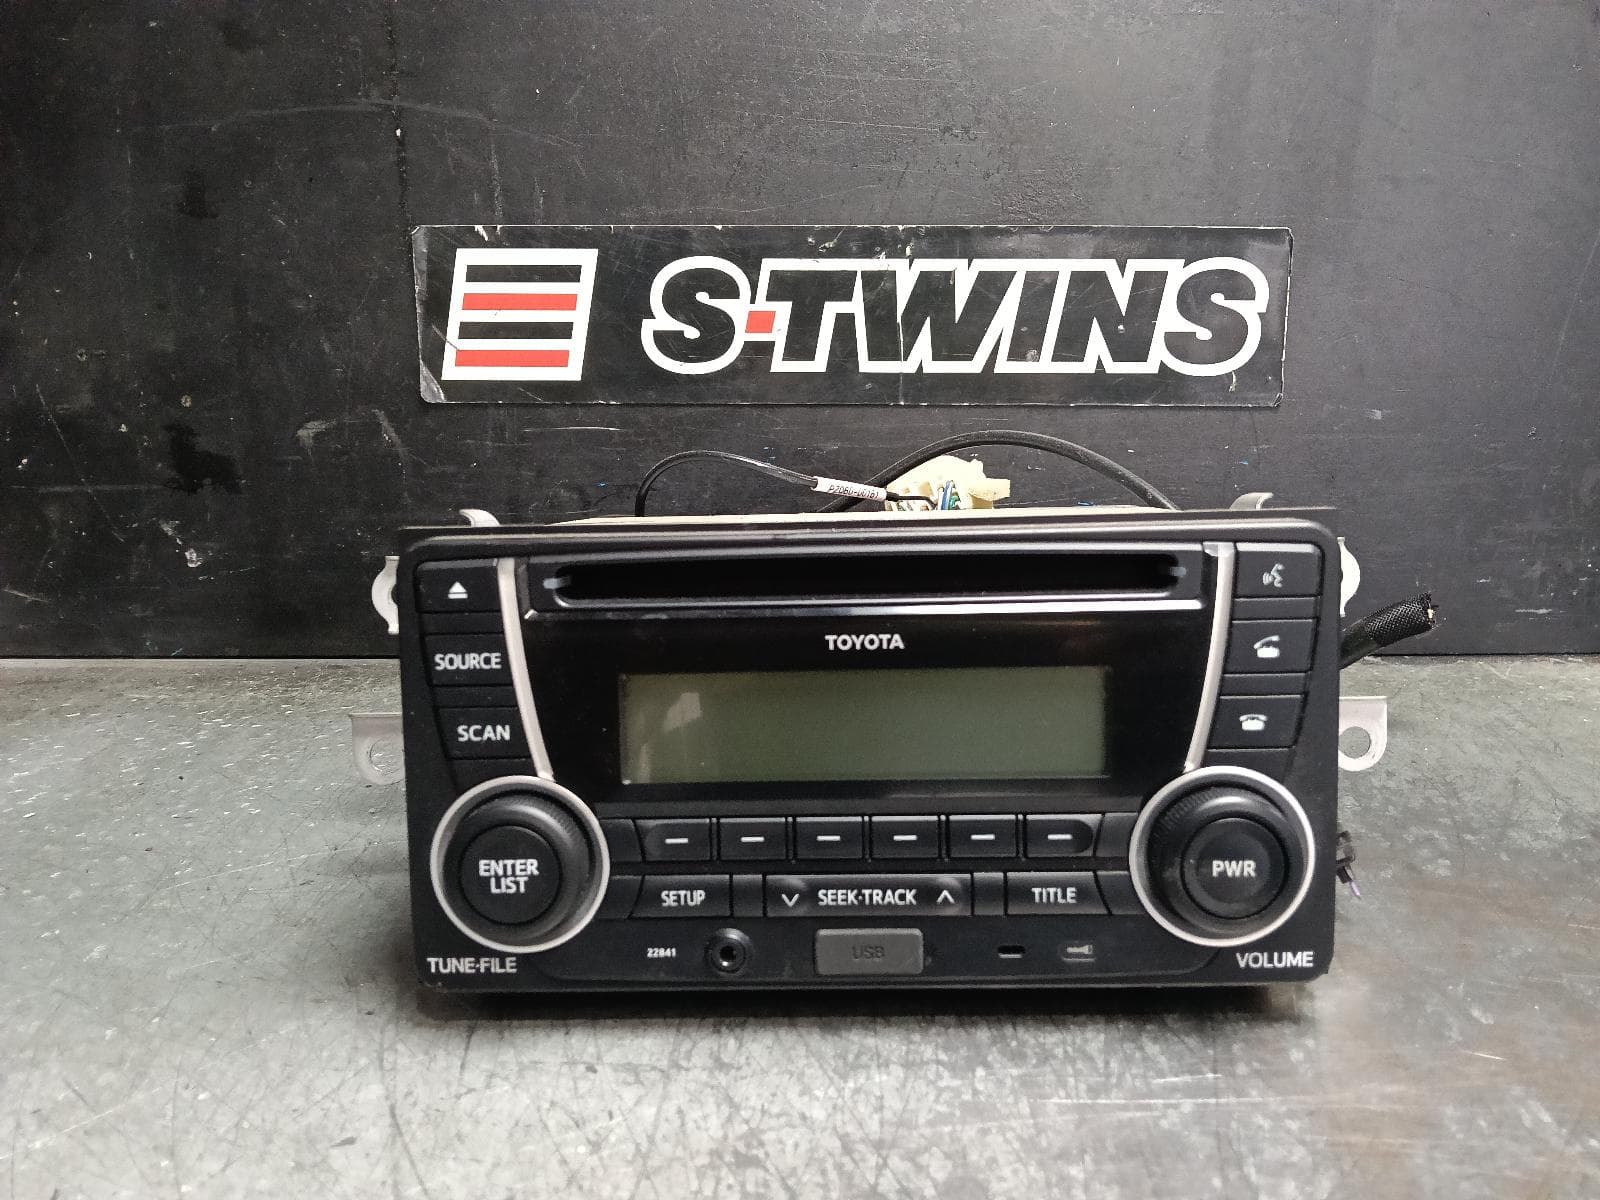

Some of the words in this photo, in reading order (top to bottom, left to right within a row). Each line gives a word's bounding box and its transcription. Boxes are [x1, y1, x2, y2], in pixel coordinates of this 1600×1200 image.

[824, 633, 905, 651] TOYOTA
[434, 652, 502, 671] SOURCE
[457, 723, 511, 742] SCAN
[478, 858, 539, 877] ENTER
[1212, 859, 1257, 878] PWR
[489, 876, 529, 895] LIST
[661, 889, 706, 908] SETUP
[1031, 886, 1077, 905] TITLE
[647, 947, 677, 958] 22841
[851, 943, 886, 961] USB
[1236, 950, 1315, 970] VOLUME
